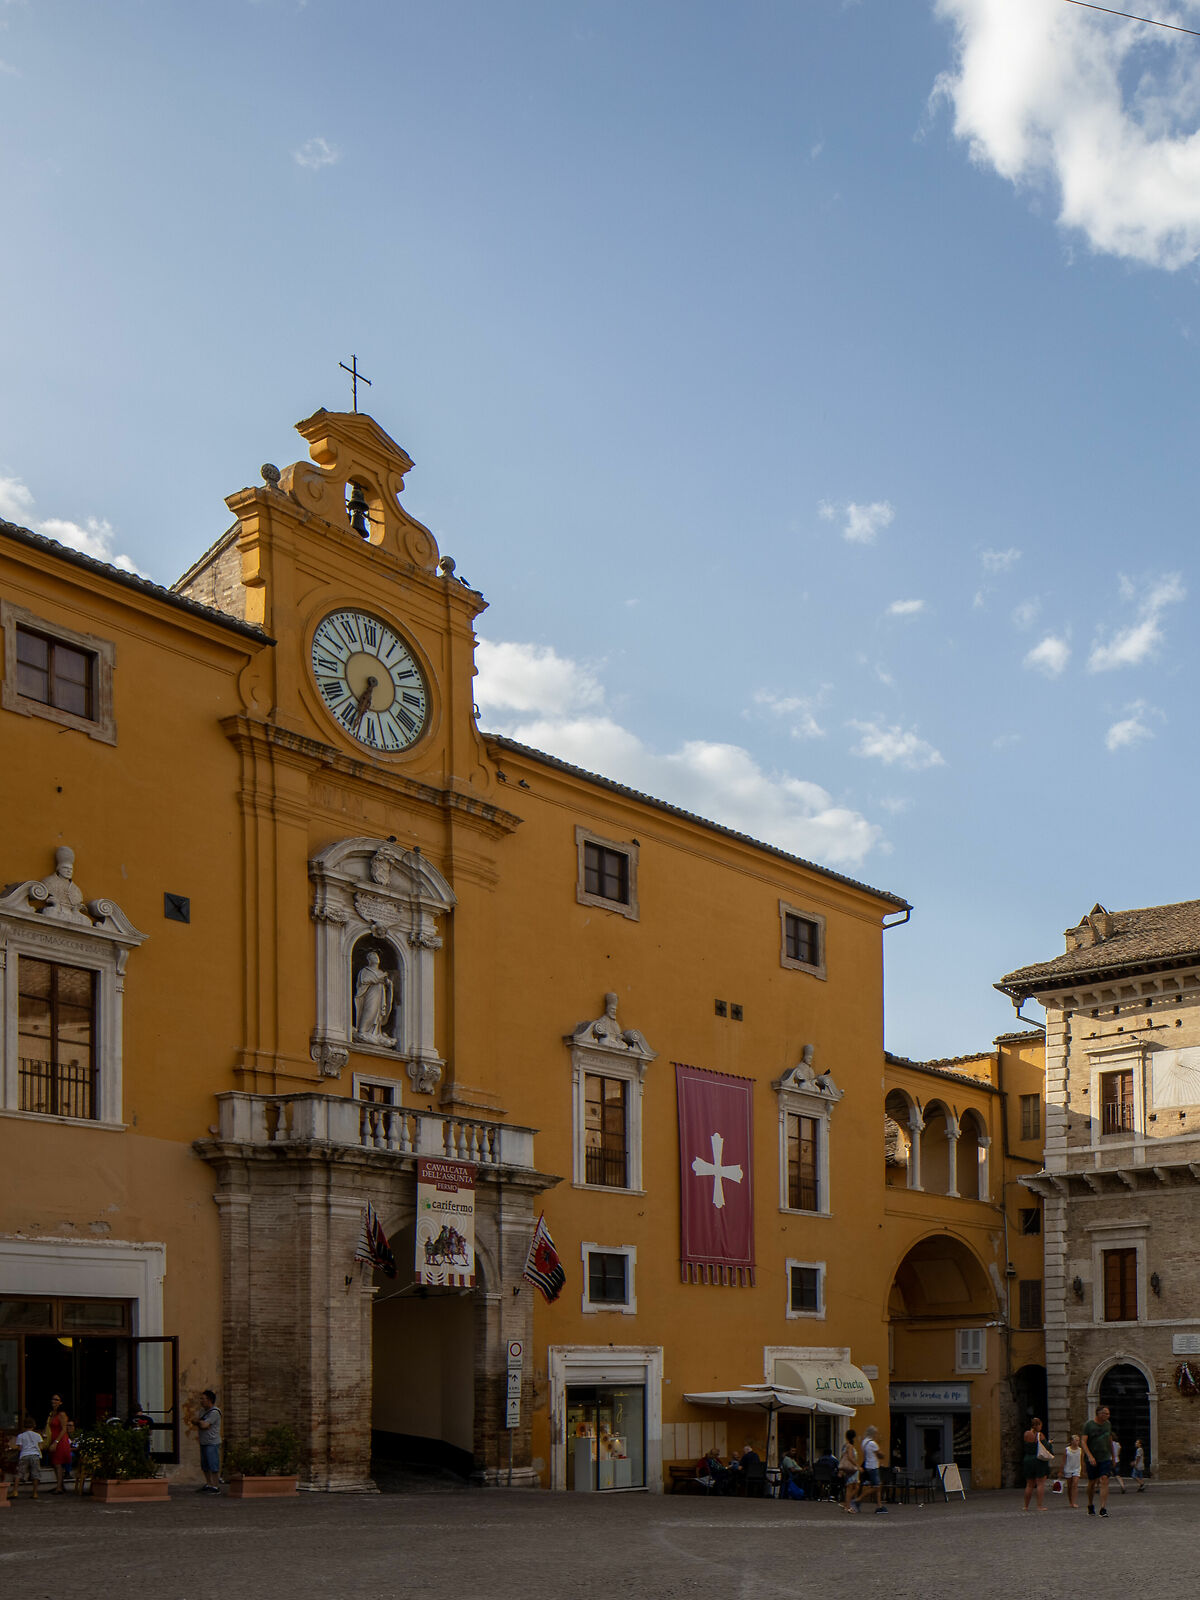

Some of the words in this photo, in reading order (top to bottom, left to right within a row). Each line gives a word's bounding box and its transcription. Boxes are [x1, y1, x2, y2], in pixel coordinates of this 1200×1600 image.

[364, 623, 377, 648] XII
[397, 669, 415, 681] II
[402, 692, 421, 708] III
[426, 1163, 468, 1175] CAVALCATA
[422, 1170, 473, 1184] DELL'ASSUNTA
[437, 1183, 457, 1191] FERMO
[432, 1200, 473, 1213] carifermo
[816, 1377, 830, 1390] La
[829, 1377, 864, 1389] Veneta
